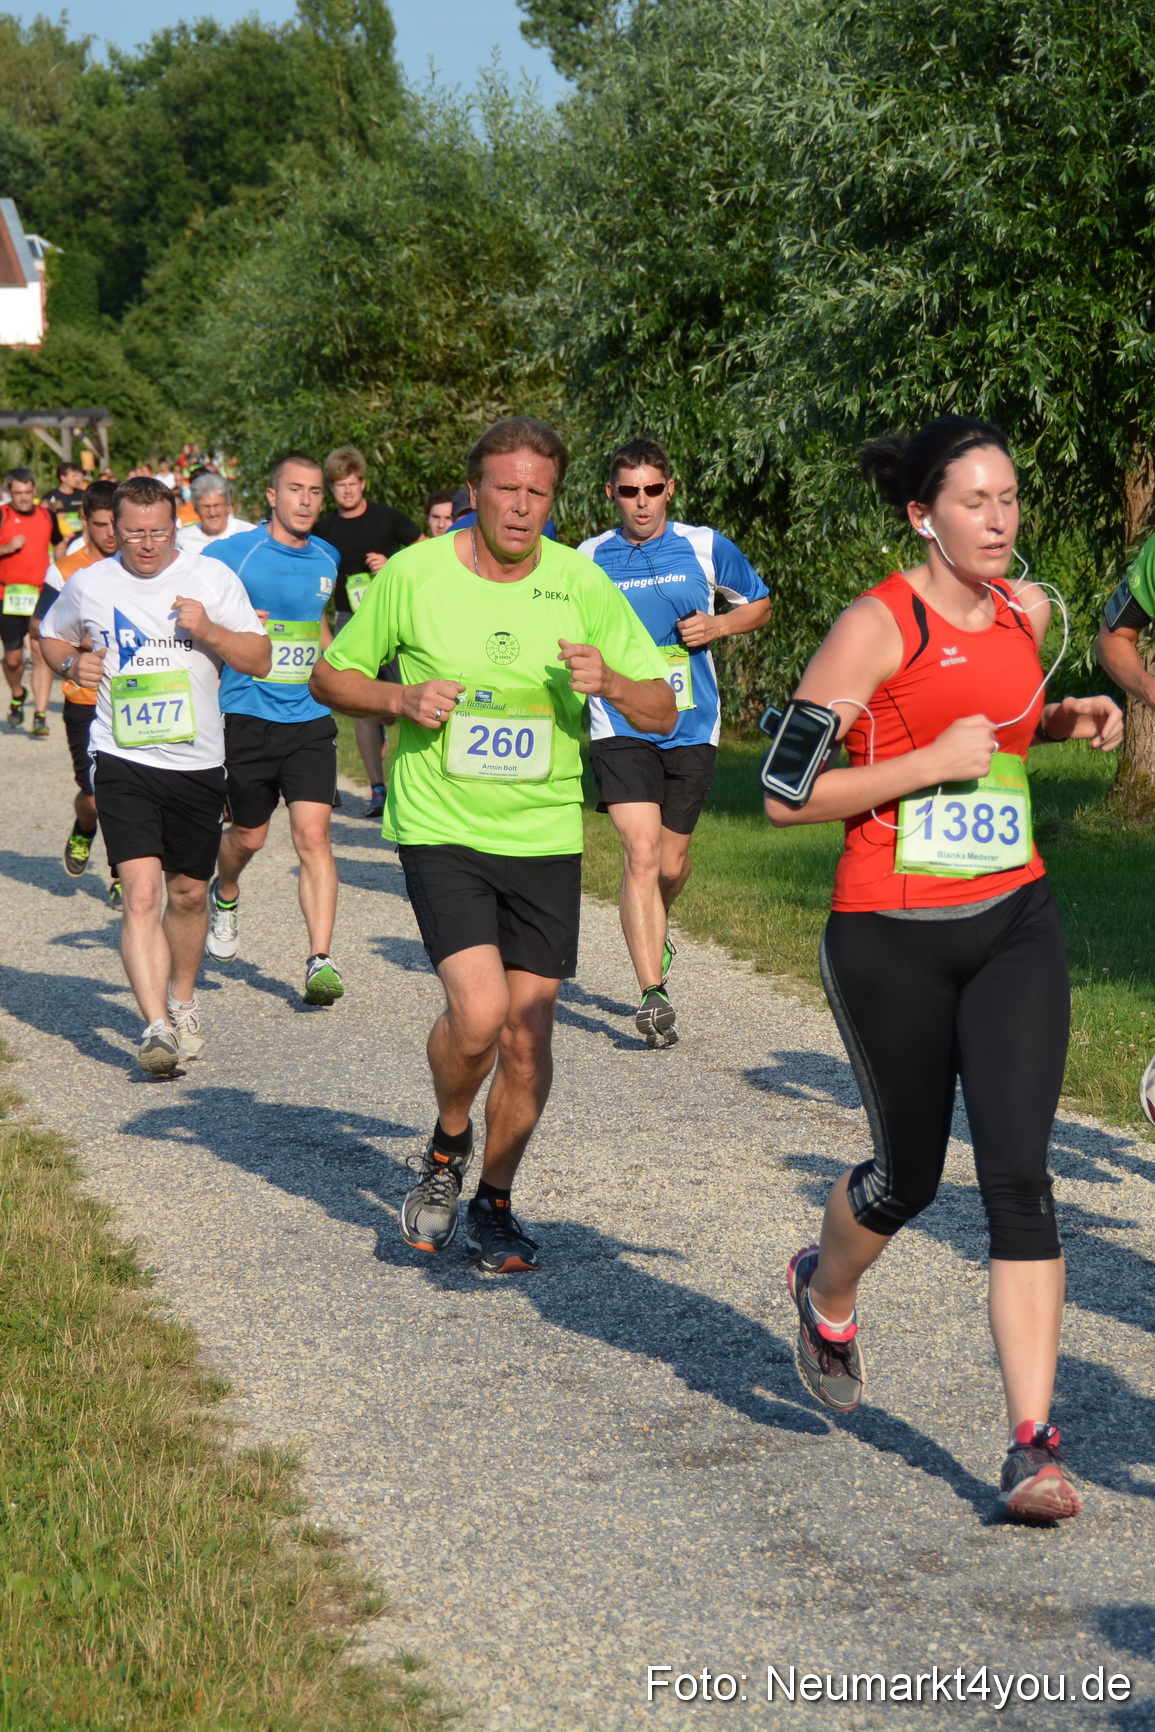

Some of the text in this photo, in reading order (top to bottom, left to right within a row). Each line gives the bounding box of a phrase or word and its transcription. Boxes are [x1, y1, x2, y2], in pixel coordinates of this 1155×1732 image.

[545, 591, 569, 602] DEKA
[128, 654, 170, 667] Team
[940, 656, 967, 668] erima
[466, 699, 507, 711] firmenlauf
[120, 699, 184, 726] 1477
[467, 725, 534, 758] 260
[482, 763, 503, 771] Armin
[915, 800, 1020, 846] 1383
[937, 850, 999, 862] Bianka Mederer
